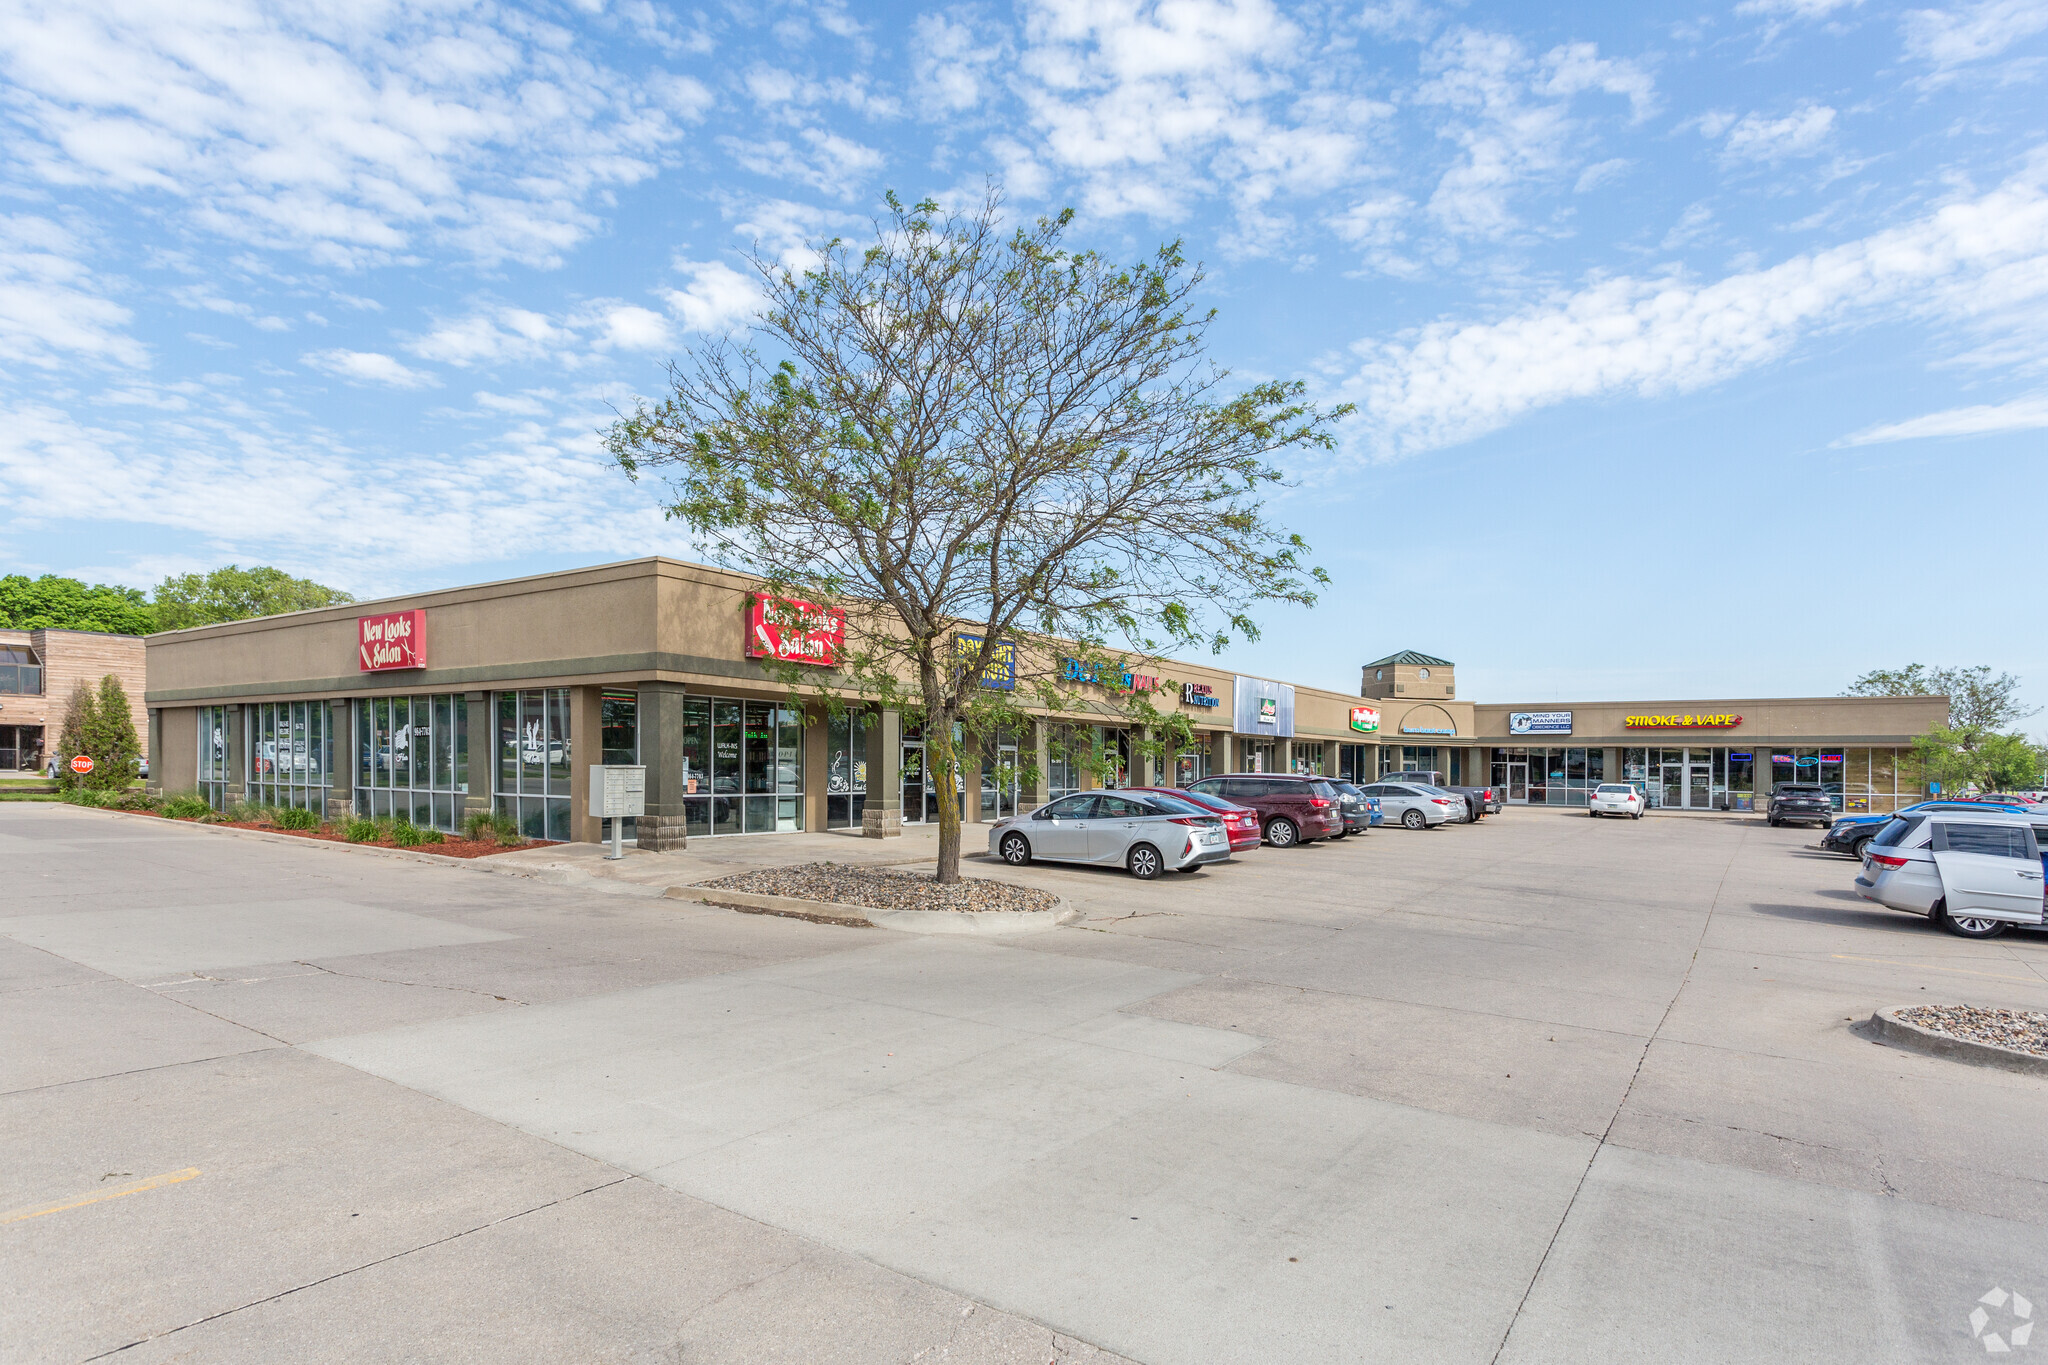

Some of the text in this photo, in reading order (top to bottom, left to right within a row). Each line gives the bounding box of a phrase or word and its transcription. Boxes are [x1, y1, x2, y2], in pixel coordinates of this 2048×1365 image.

[363, 615, 411, 644] New Looks
[778, 630, 824, 657] Salon
[373, 642, 402, 668] Salon
[1126, 673, 1160, 693] NAILS
[1193, 695, 1219, 707] NUTRITION
[1625, 714, 1735, 726] SMOKE & VAPE
[1420, 726, 1435, 734] boot
[1436, 728, 1456, 736] camp
[72, 760, 93, 769] STOP
